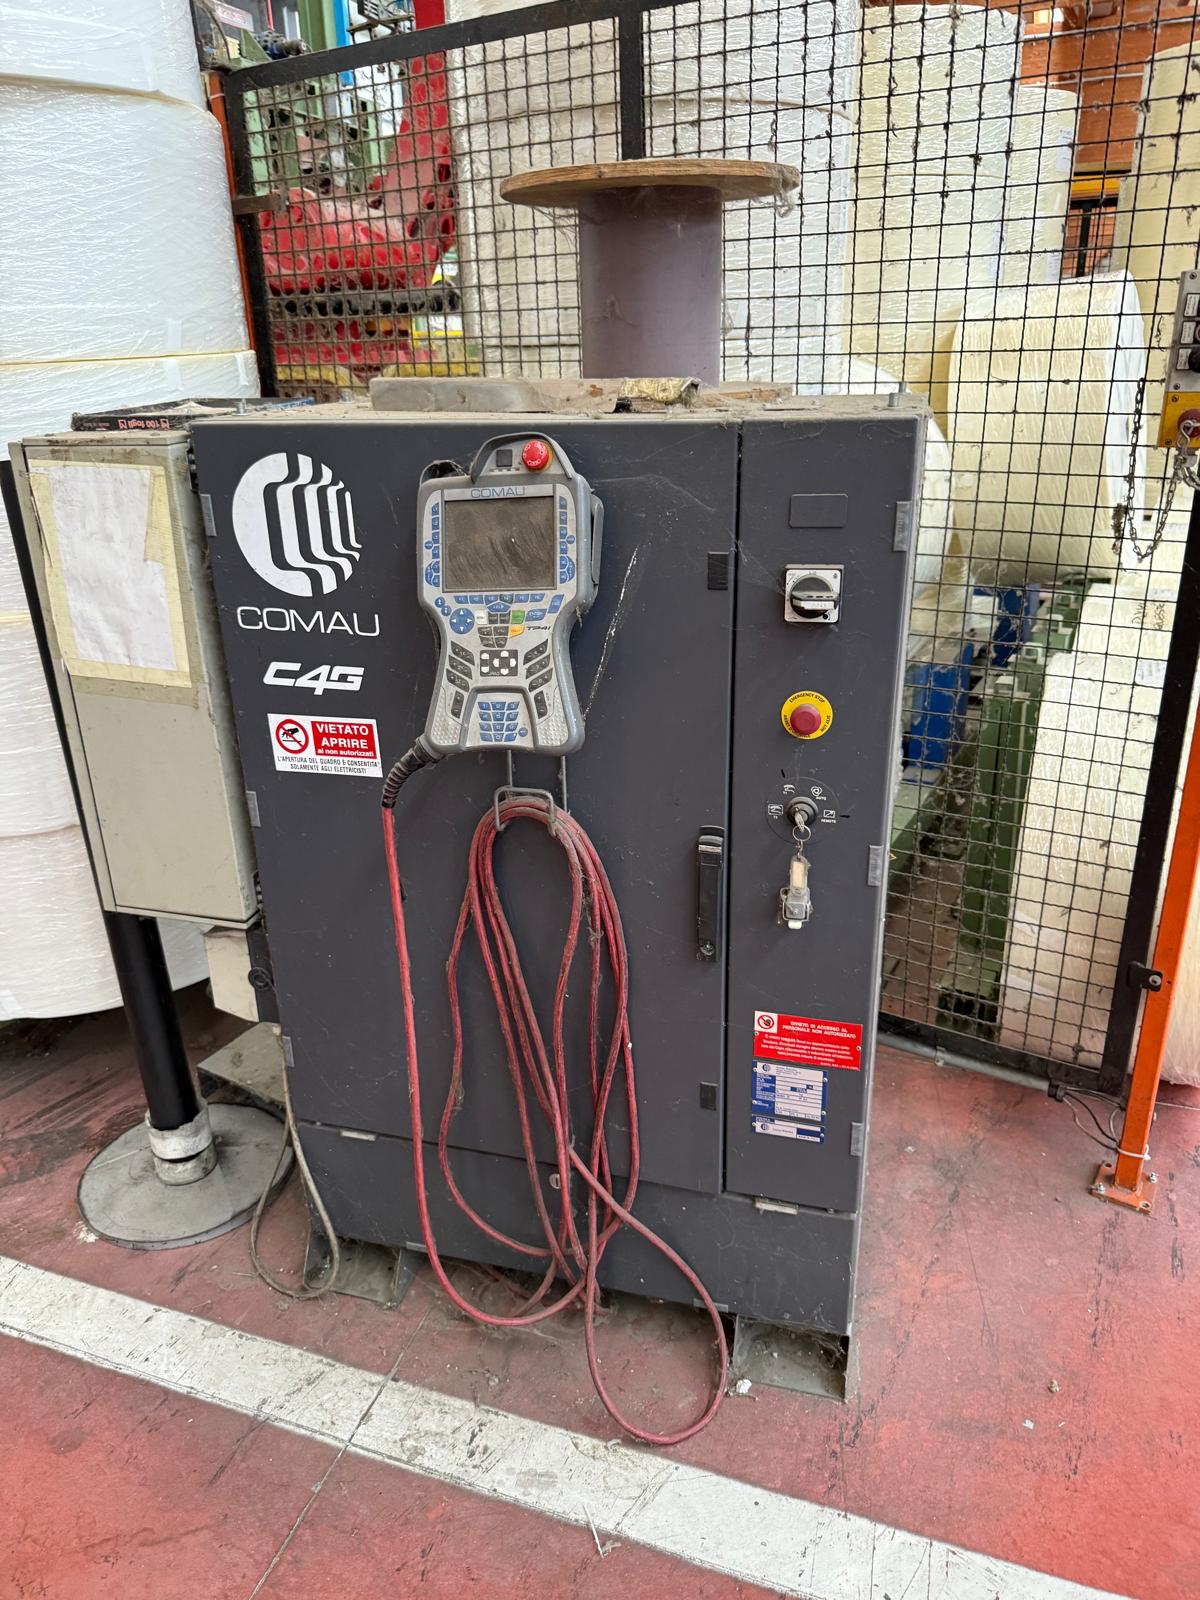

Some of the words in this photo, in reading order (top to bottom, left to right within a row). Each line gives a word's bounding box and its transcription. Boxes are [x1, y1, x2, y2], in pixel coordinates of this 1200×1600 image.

[471, 487, 526, 498] COMAU
[236, 606, 380, 637] COMAU
[263, 662, 365, 695] C4G
[789, 692, 814, 703] EMERGENCY
[814, 693, 826, 703] STOP
[316, 723, 369, 736] VIETATO
[321, 737, 369, 749] APRIRE
[340, 749, 374, 757] autorizzati
[319, 758, 341, 766] QUADRO
[290, 763, 320, 772] SOLAMENTE
[333, 765, 367, 774] ELETTRICISTI
